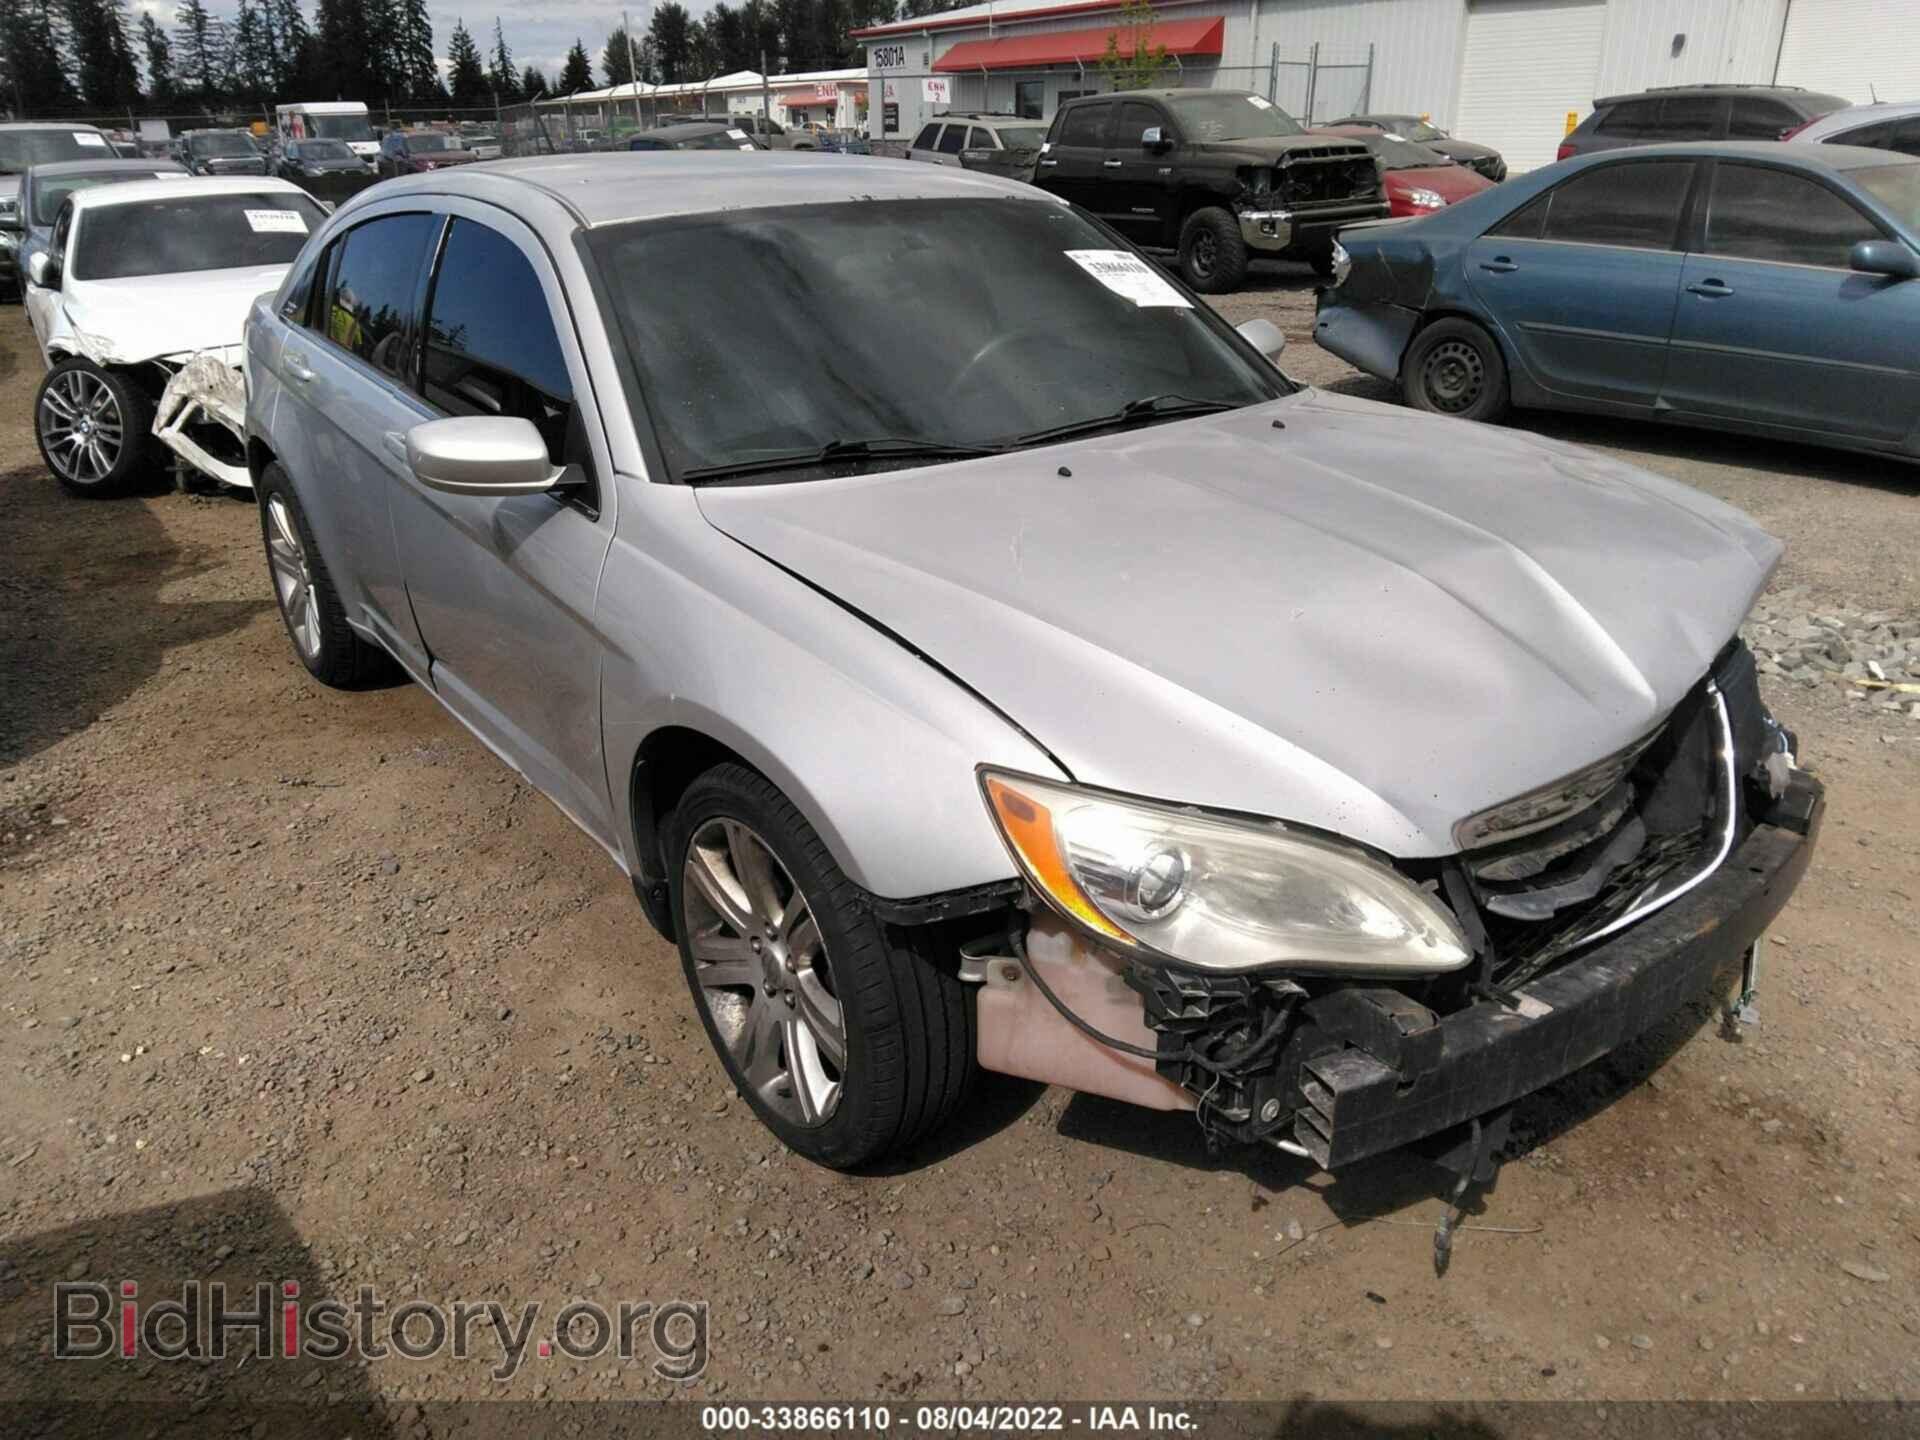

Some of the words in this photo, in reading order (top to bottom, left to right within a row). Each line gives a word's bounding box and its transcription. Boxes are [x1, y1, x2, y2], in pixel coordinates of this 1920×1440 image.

[873, 46, 905, 67] 15801A
[815, 84, 837, 97] ENH
[927, 81, 945, 92] ENH
